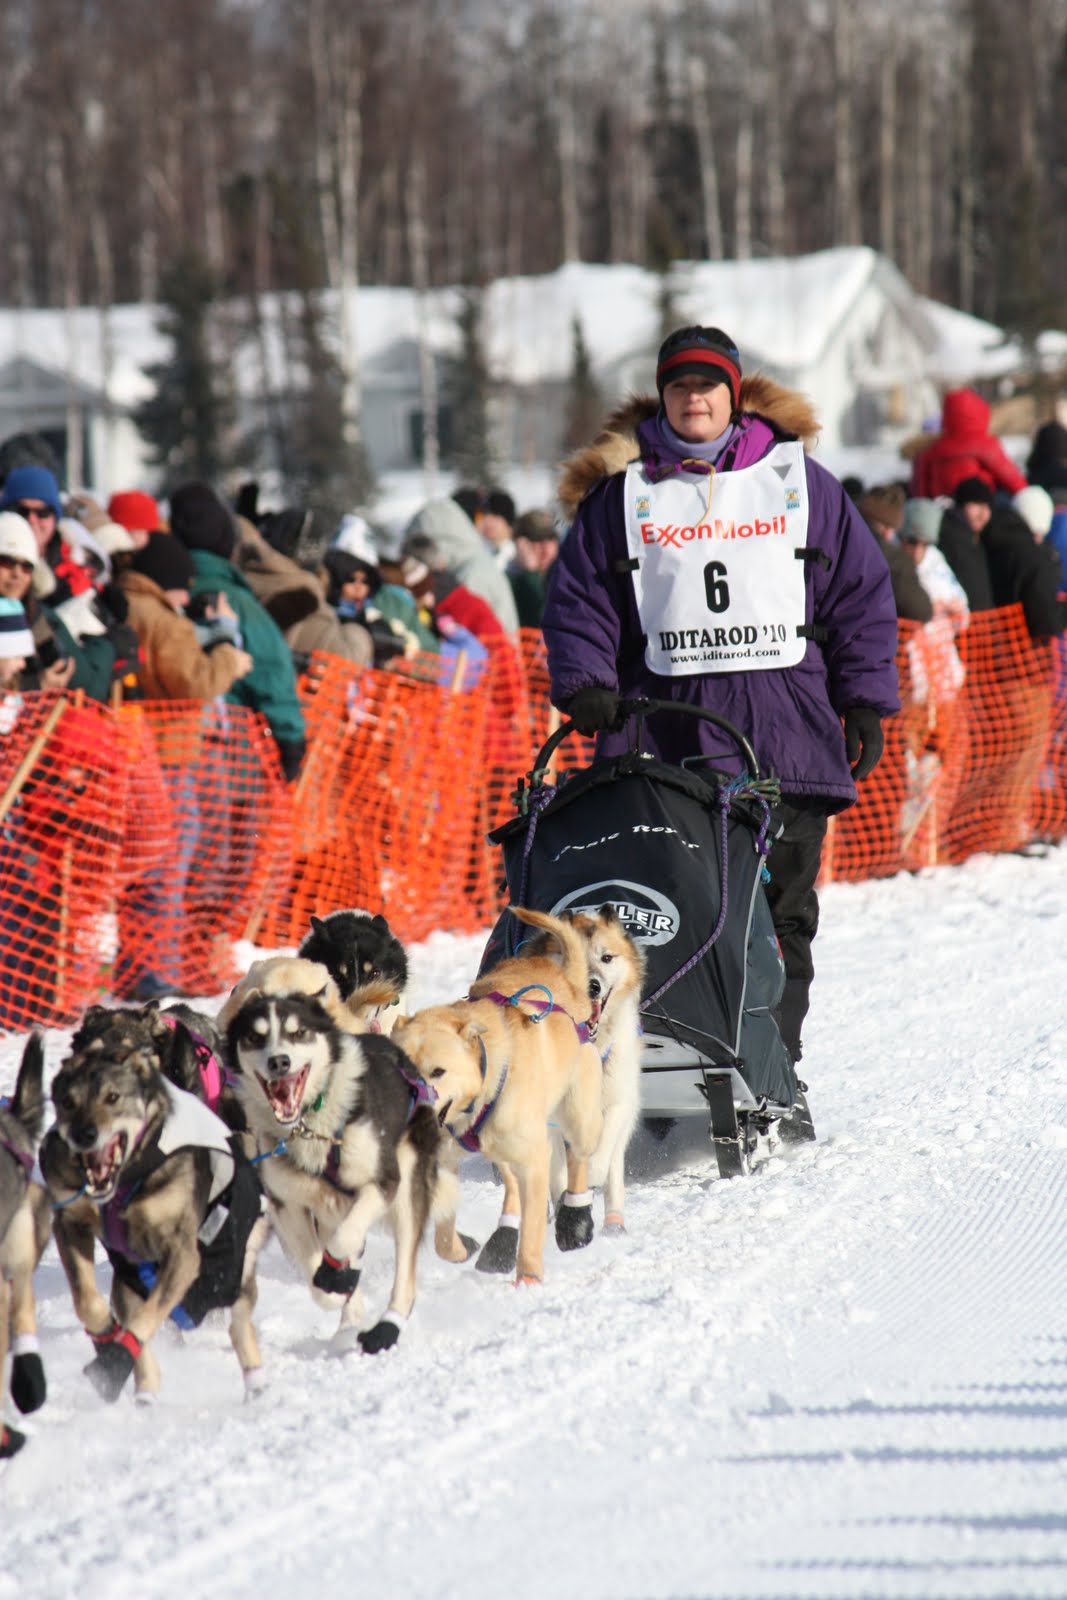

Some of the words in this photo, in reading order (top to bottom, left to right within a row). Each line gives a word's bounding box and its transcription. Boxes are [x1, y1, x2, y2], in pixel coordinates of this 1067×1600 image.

[641, 515, 786, 548] ExxonMobil
[703, 560, 730, 613] 6
[660, 626, 758, 651] IDITAROD
[762, 624, 787, 642] '10
[670, 647, 781, 664] www.iditarod.com
